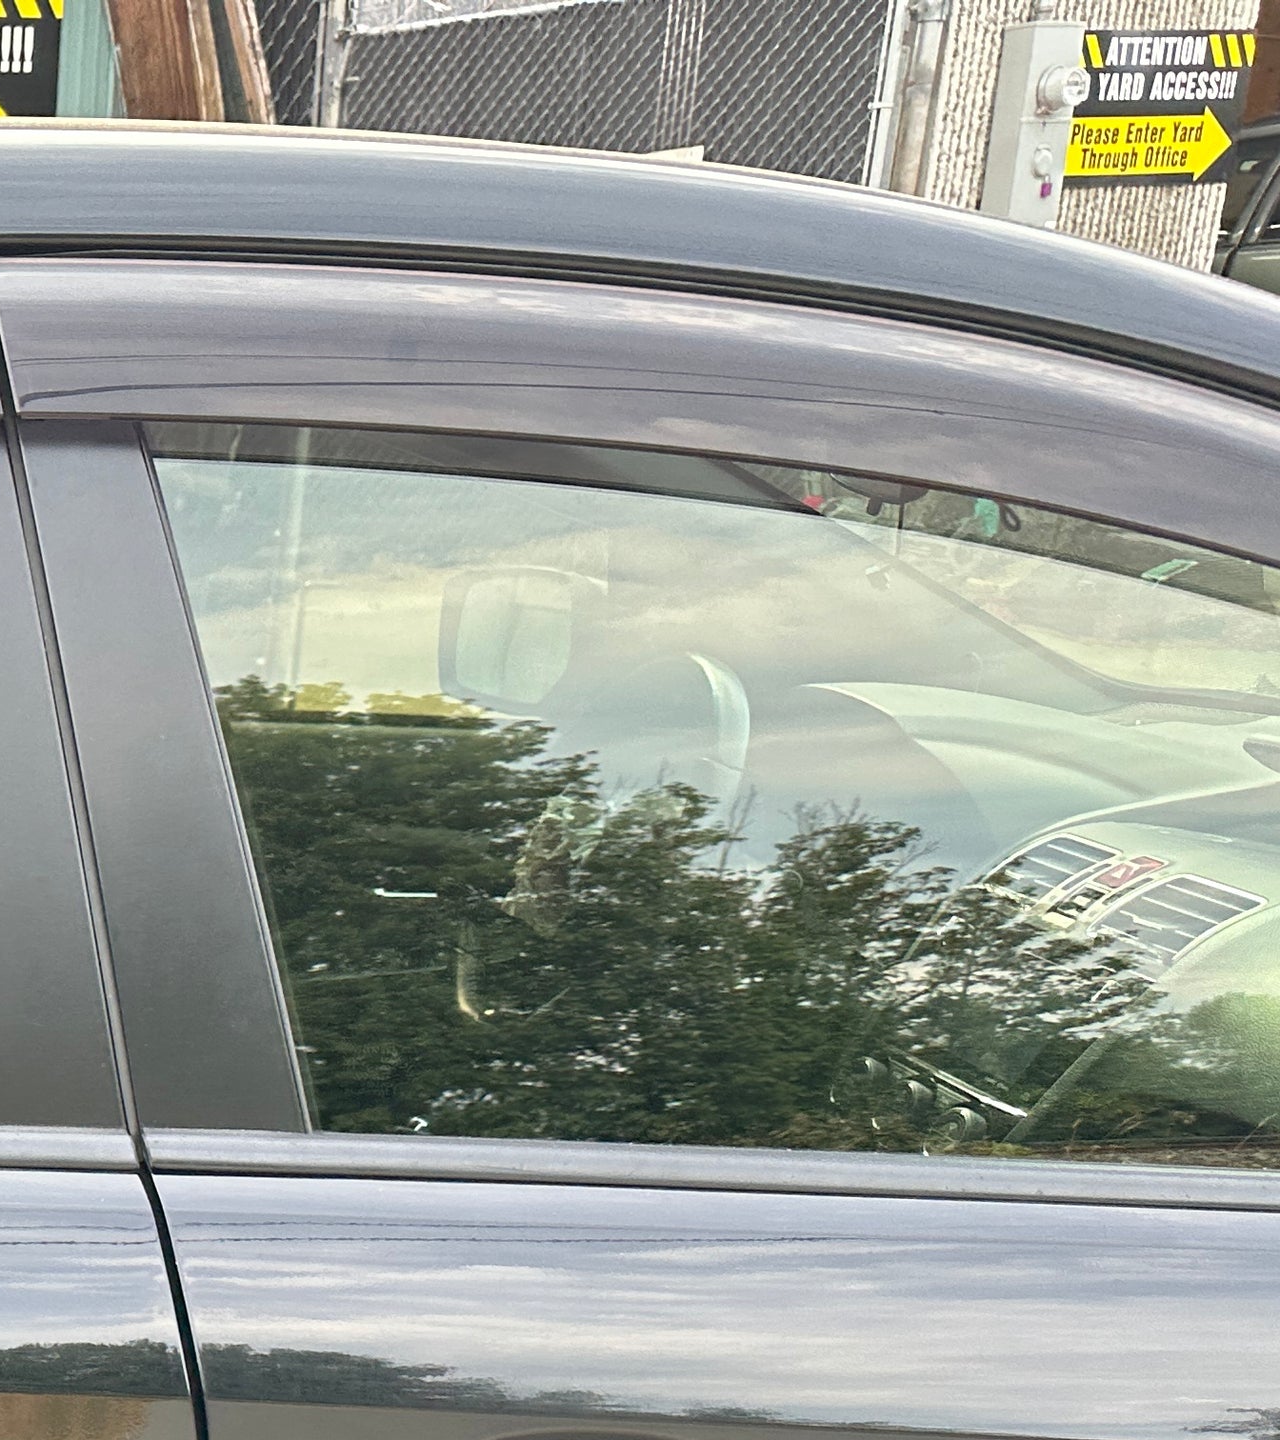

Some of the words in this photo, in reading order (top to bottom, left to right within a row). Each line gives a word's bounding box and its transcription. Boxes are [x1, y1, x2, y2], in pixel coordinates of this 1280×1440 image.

[1105, 36, 1209, 66] ATTENTION
[1098, 71, 1146, 101] YARD
[1149, 71, 1238, 100] ACCESS!!!
[1070, 124, 1119, 145] Please
[1125, 122, 1166, 144] Enter
[1172, 121, 1204, 143] Yard
[1081, 147, 1137, 171] Through
[1144, 147, 1188, 169] Office
